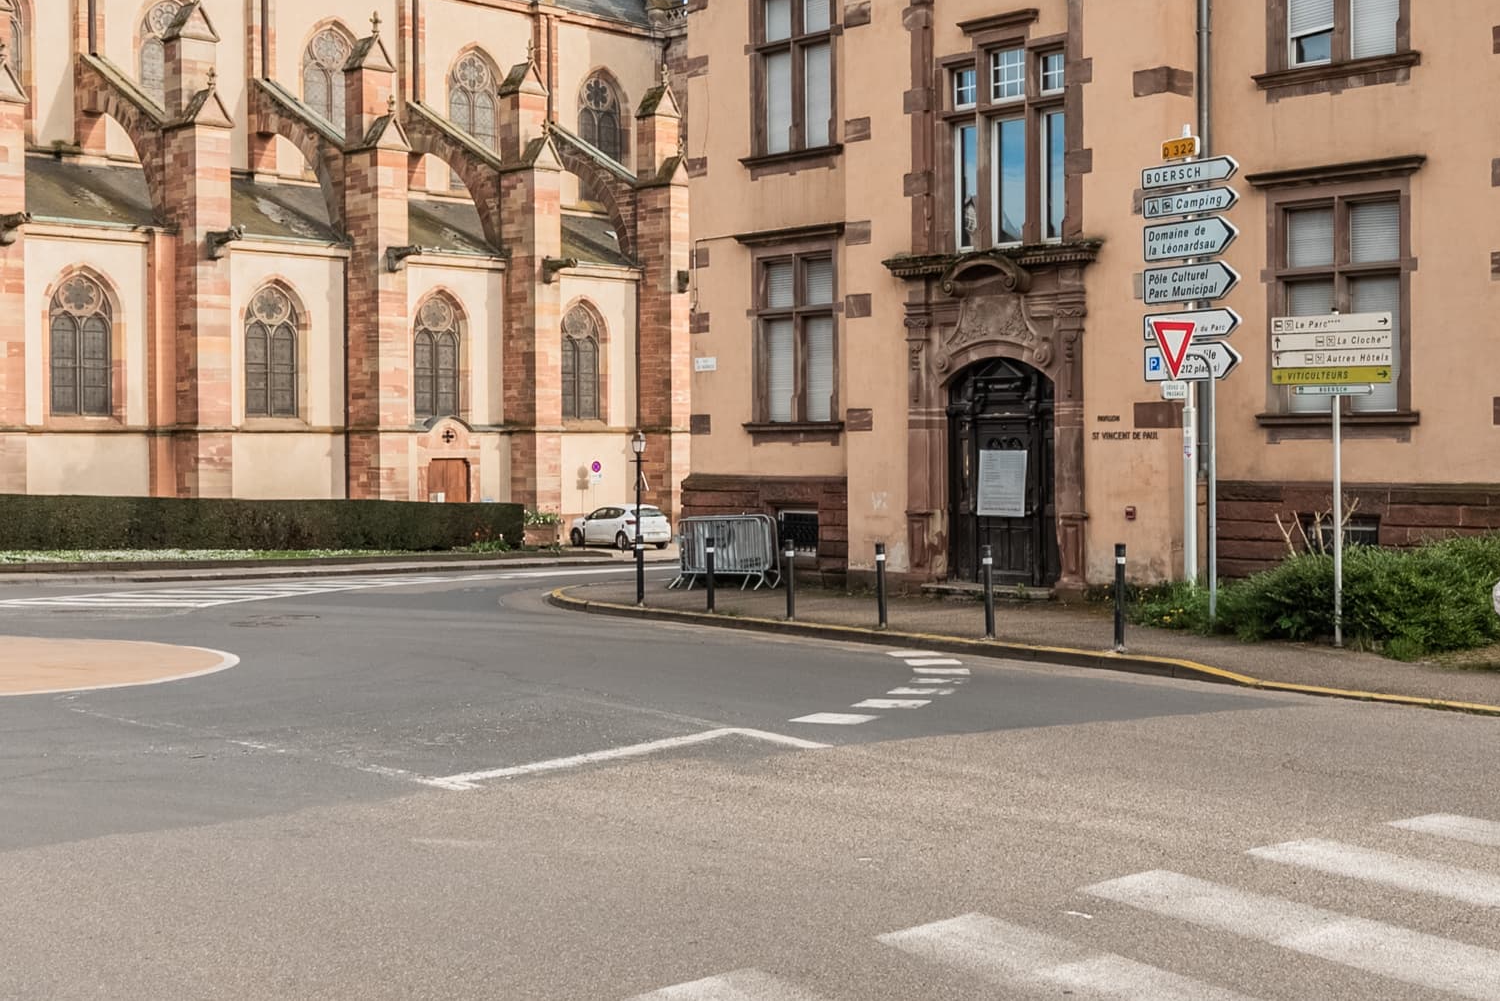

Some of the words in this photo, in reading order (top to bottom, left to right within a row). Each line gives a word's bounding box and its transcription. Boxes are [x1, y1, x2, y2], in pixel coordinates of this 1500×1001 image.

[1163, 147, 1170, 158] D
[1174, 142, 1194, 155] 322
[1146, 167, 1201, 184] BOERSCH
[1176, 194, 1222, 210] Camping
[1148, 227, 1189, 242] Domaine
[1194, 225, 1206, 237] de
[1148, 246, 1157, 256] la
[1162, 237, 1216, 253] Léonardsau
[1148, 272, 1168, 285] Pôle
[1172, 269, 1209, 283] Culturel
[1149, 288, 1168, 299] Parc
[1172, 282, 1218, 297] Municipal
[1211, 323, 1226, 332] Parc
[1295, 320, 1305, 329] Le
[1326, 353, 1356, 363] Autres
[1360, 351, 1389, 362] Hôtels
[1287, 370, 1349, 380] VITICULTEURS
[1092, 432, 1100, 440] ST
[1102, 431, 1130, 440] VINCENT
[1133, 432, 1141, 440] DE
[1143, 431, 1158, 440] PAUL
